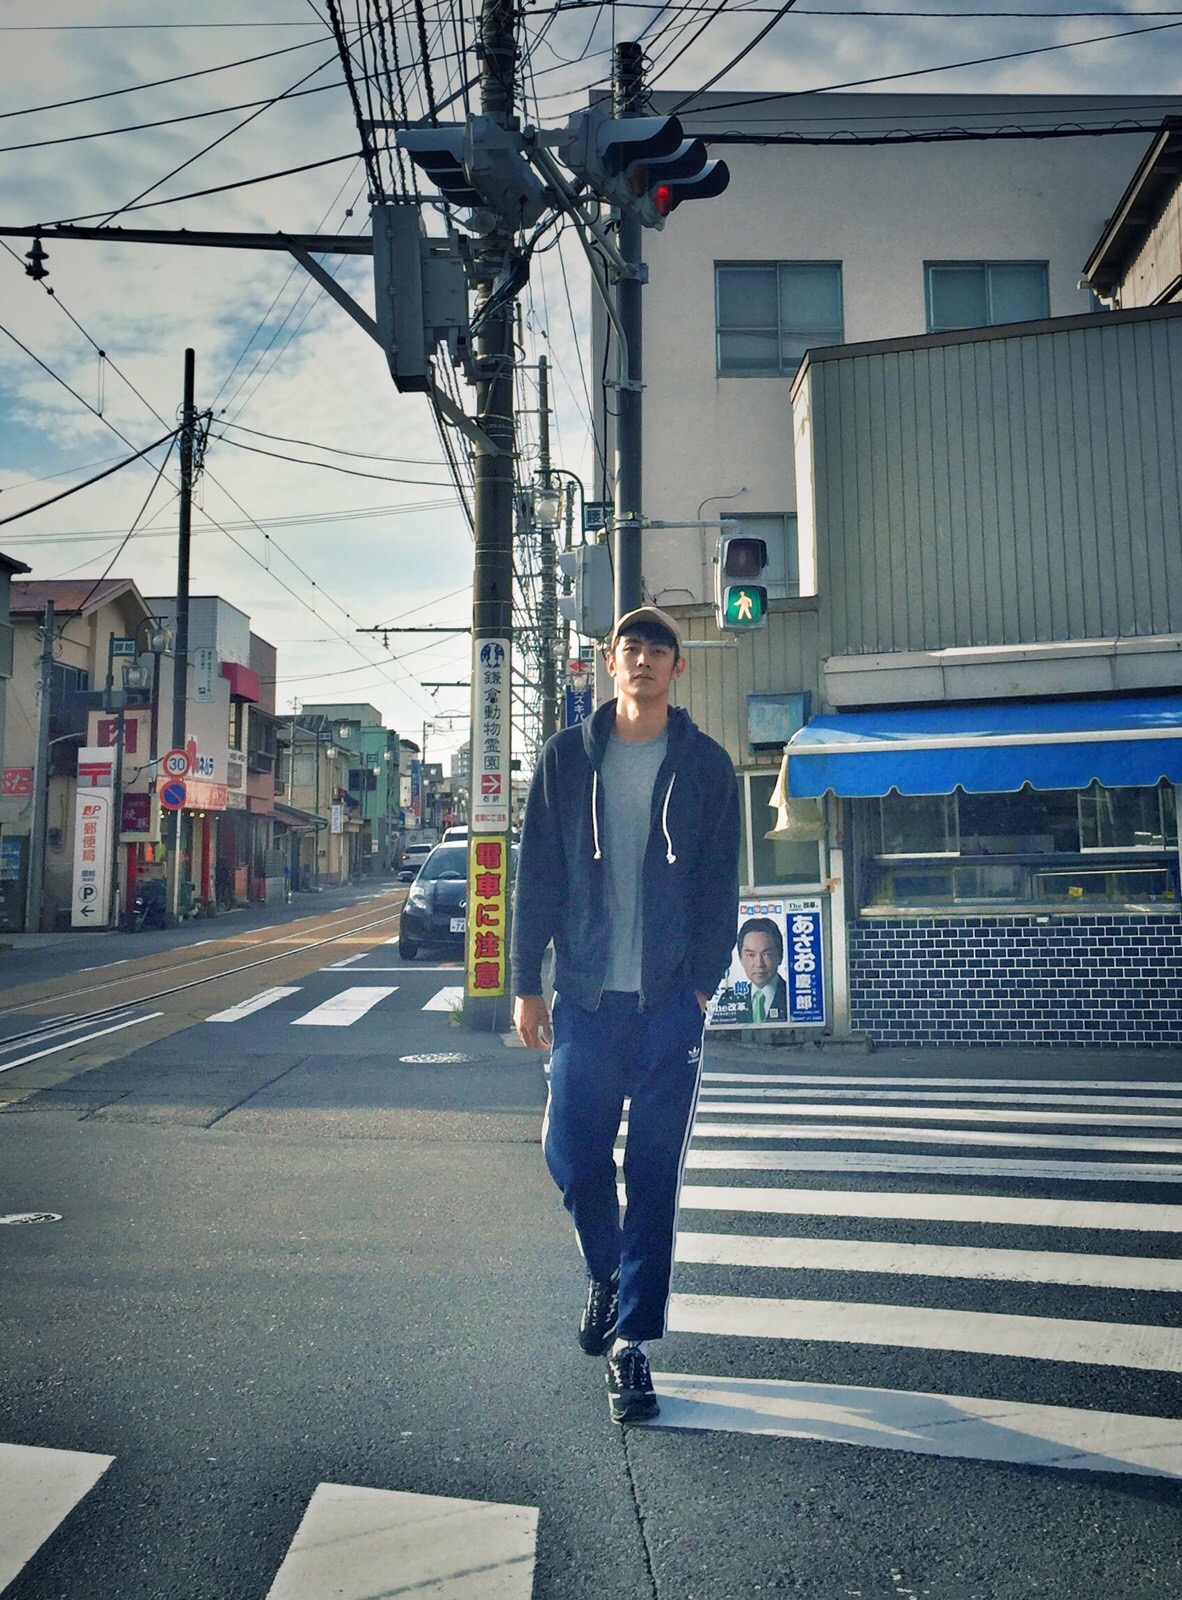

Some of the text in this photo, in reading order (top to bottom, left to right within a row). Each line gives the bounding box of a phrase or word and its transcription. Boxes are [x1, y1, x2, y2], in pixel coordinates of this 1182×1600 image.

[483, 671, 502, 771] 鎌倉動物霊園
[169, 757, 185, 771] 30
[82, 822, 97, 862] 郵便局
[83, 887, 94, 900] P
[474, 842, 502, 990] 電車に注意
